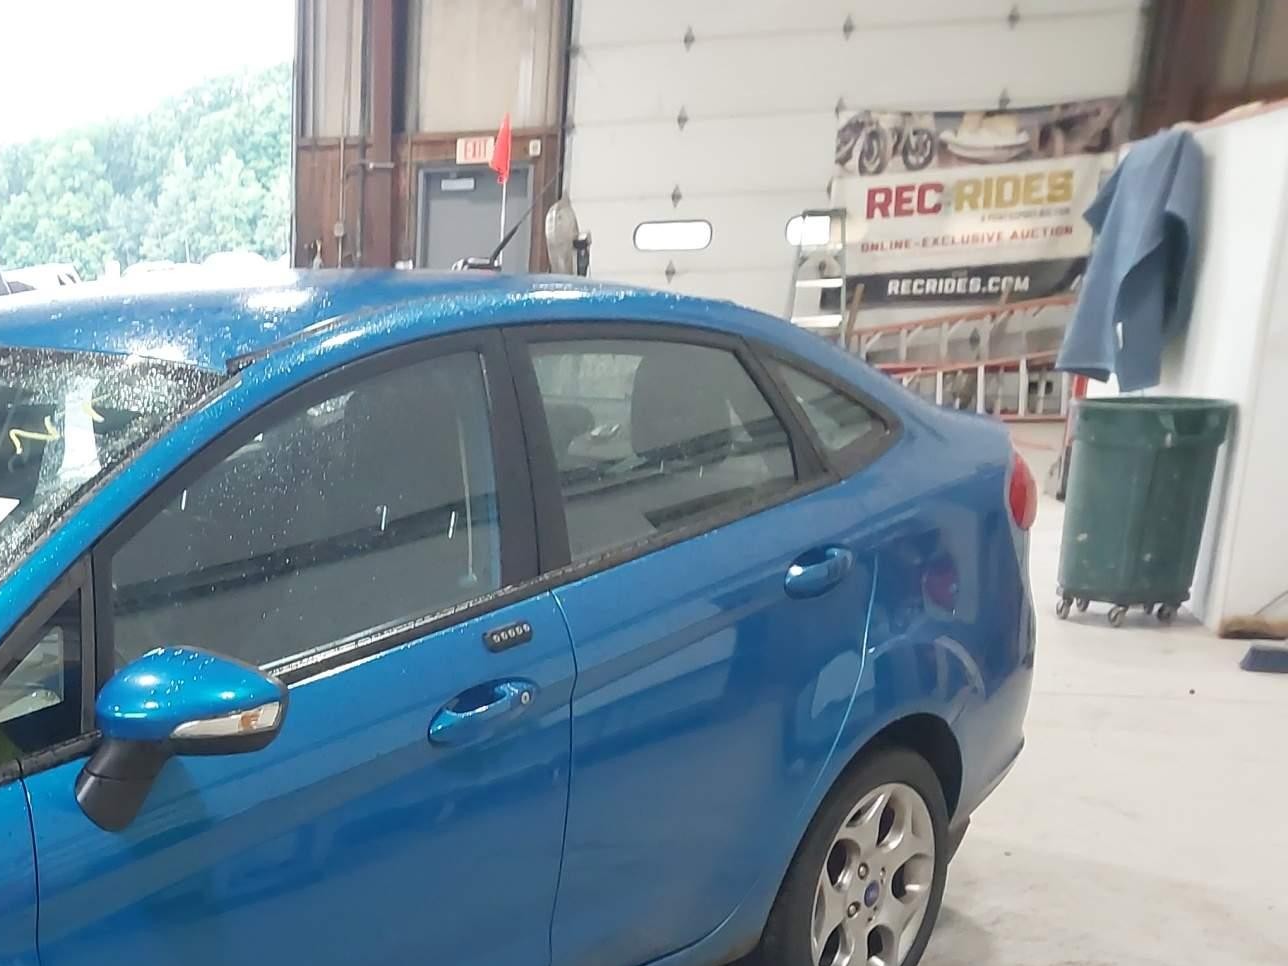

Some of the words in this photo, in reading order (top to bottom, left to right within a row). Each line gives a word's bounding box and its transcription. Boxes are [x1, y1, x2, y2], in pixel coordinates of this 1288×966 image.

[866, 182, 945, 220] REC
[955, 170, 1074, 211] RIDES
[1010, 224, 1073, 241] AUCTION
[887, 275, 1030, 297] RECRIDES.COM
